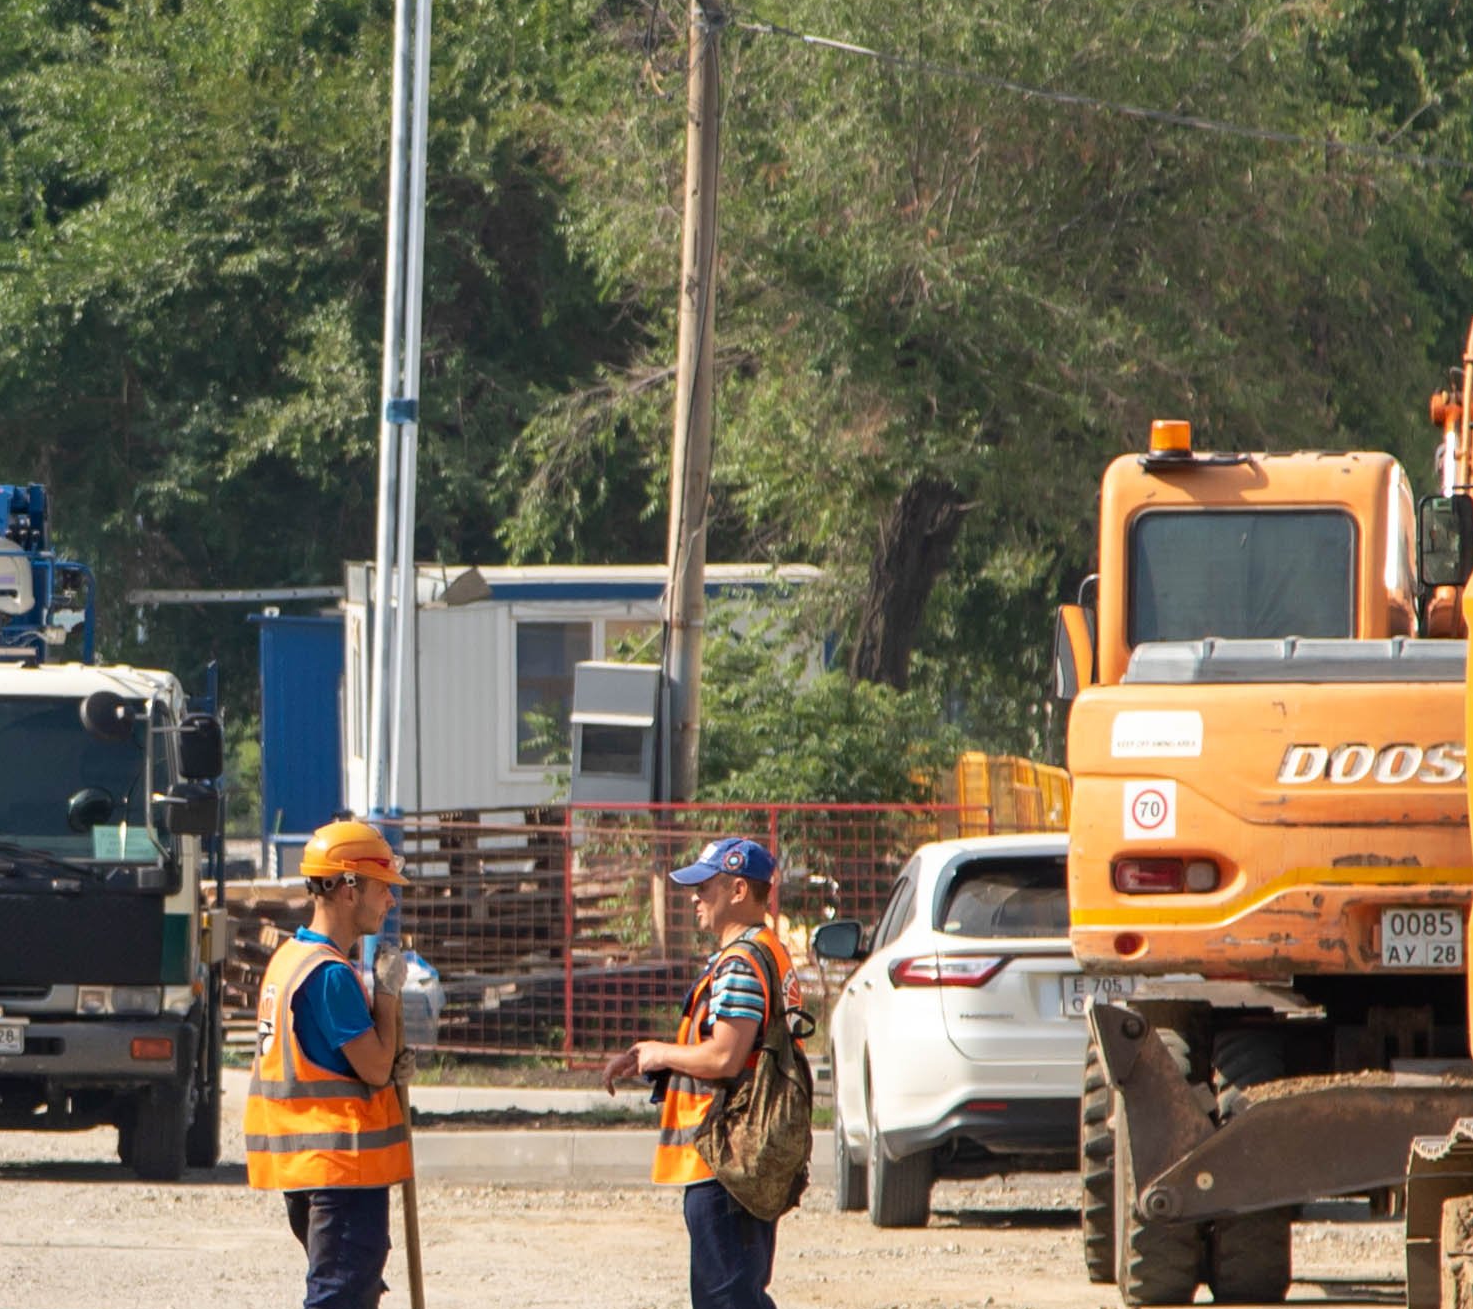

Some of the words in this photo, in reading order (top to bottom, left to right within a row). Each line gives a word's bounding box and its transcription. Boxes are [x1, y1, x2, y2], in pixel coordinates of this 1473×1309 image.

[1277, 742, 1467, 784] DOOS
[1140, 801, 1160, 818] 70
[1390, 912, 1454, 936] 0085
[1433, 944, 1456, 964] 28
